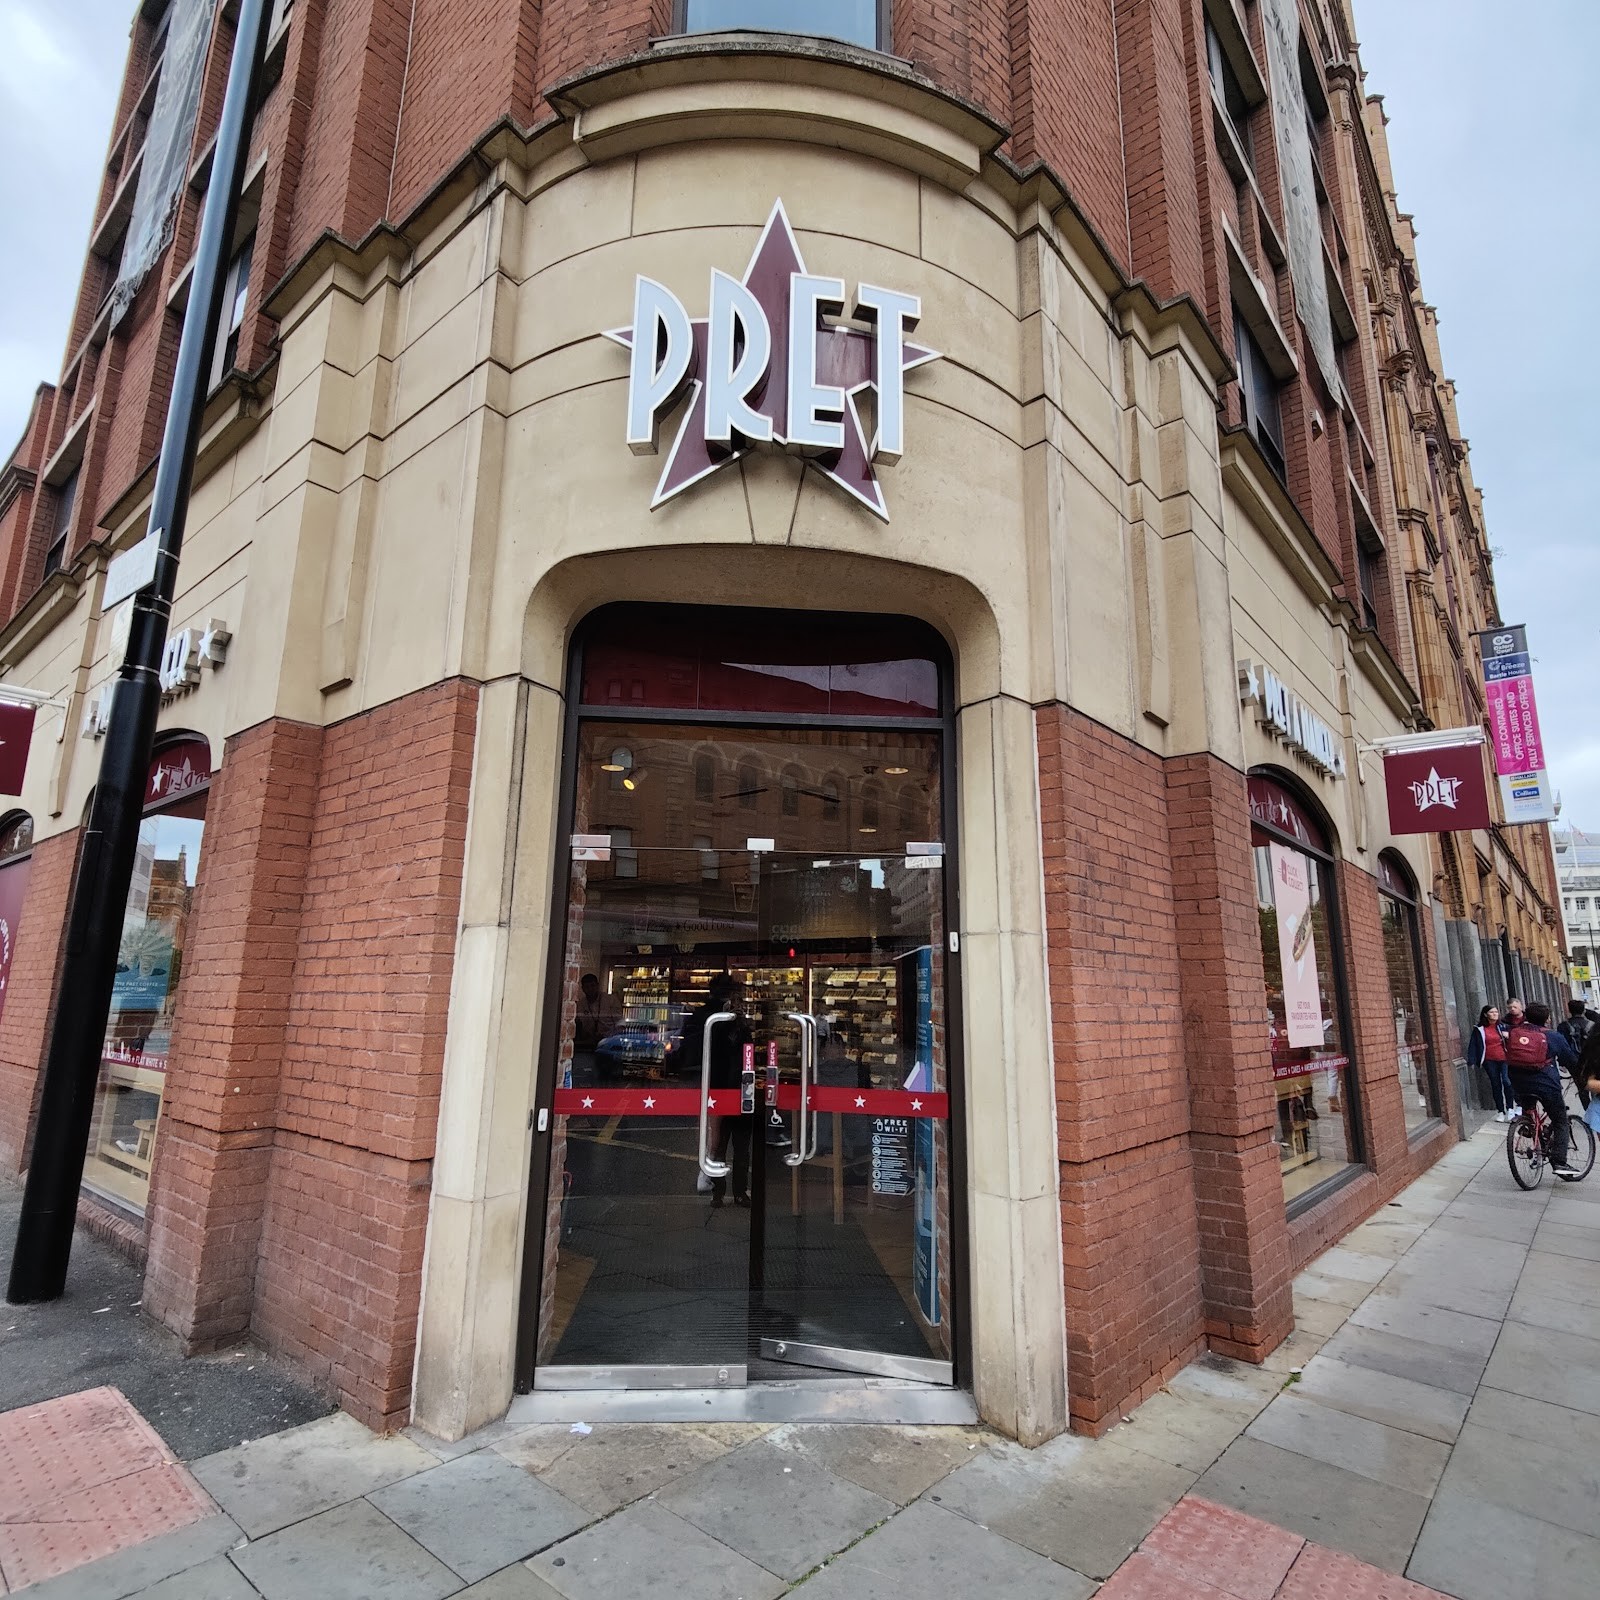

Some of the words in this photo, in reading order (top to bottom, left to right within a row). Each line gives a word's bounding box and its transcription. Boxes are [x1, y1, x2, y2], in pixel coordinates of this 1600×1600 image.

[626, 266, 921, 456] PRET
[1493, 643, 1514, 651] Oxford
[1501, 662, 1526, 671] Breeze
[1506, 692, 1517, 708] AND
[1517, 680, 1530, 709] OFFICES
[1494, 698, 1509, 741] CONTAINED
[1509, 709, 1520, 733] SUITES
[1522, 710, 1535, 747] SERVICED
[1501, 742, 1512, 758] SELF
[1512, 733, 1525, 760] OFFICE
[1527, 748, 1539, 768] FULLY
[1413, 777, 1459, 806] PRET
[884, 1118, 908, 1126] FREE
